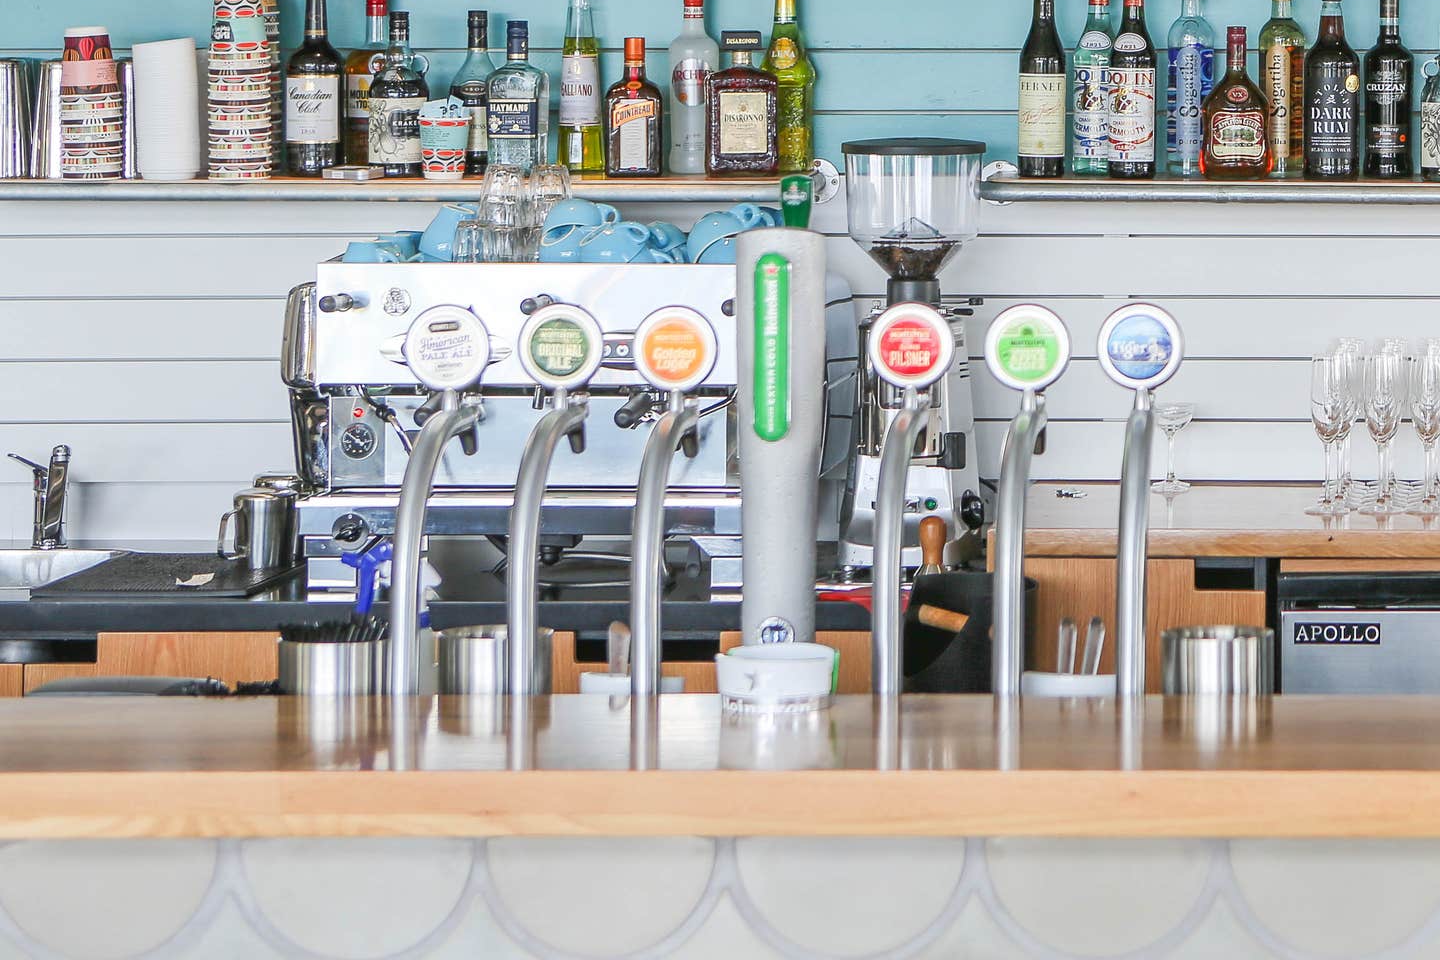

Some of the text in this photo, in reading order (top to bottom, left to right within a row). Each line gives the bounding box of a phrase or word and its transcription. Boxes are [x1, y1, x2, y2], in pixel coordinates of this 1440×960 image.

[1021, 81, 1062, 92] FERNET
[1269, 54, 1287, 118] Sagatiba
[1366, 83, 1406, 94] CRUZAN
[289, 86, 333, 101] Canadian
[296, 100, 322, 114] Club
[1310, 107, 1352, 120] DARK
[615, 104, 652, 126] COINTREAU
[724, 113, 765, 124] DISARONNO
[1313, 121, 1350, 134] RUM
[889, 349, 932, 367] PILSNER
[1295, 625, 1380, 642] APOLLO
